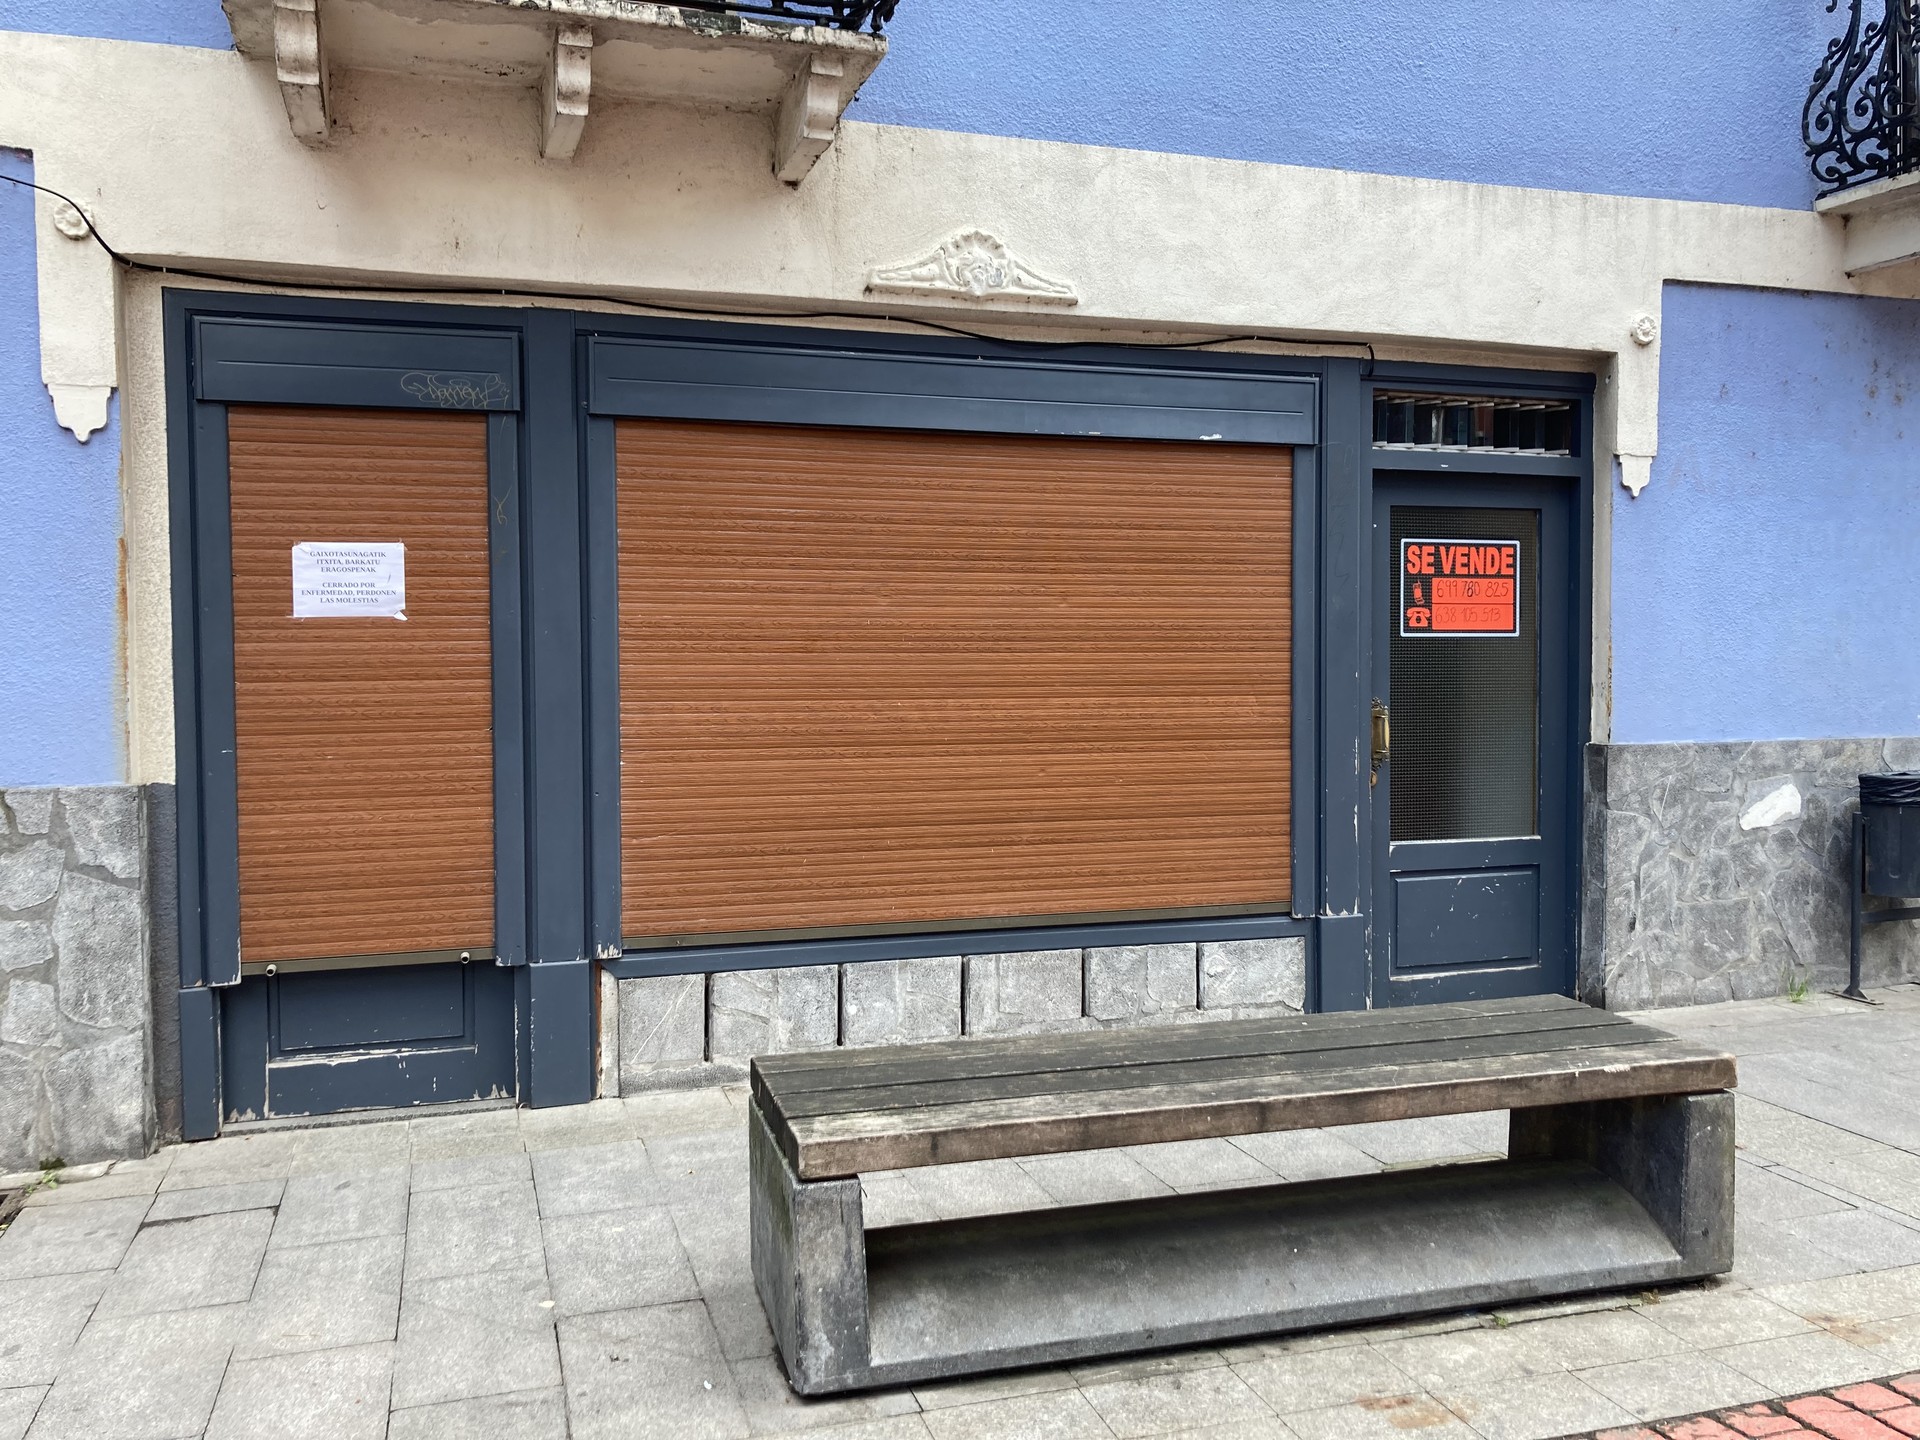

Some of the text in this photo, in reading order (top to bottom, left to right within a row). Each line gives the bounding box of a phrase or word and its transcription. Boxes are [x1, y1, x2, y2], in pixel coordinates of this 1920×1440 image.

[316, 558, 344, 566] ITXITA,
[1407, 545, 1514, 575] SE VENDE
[1436, 579, 1509, 598] 699 780 825
